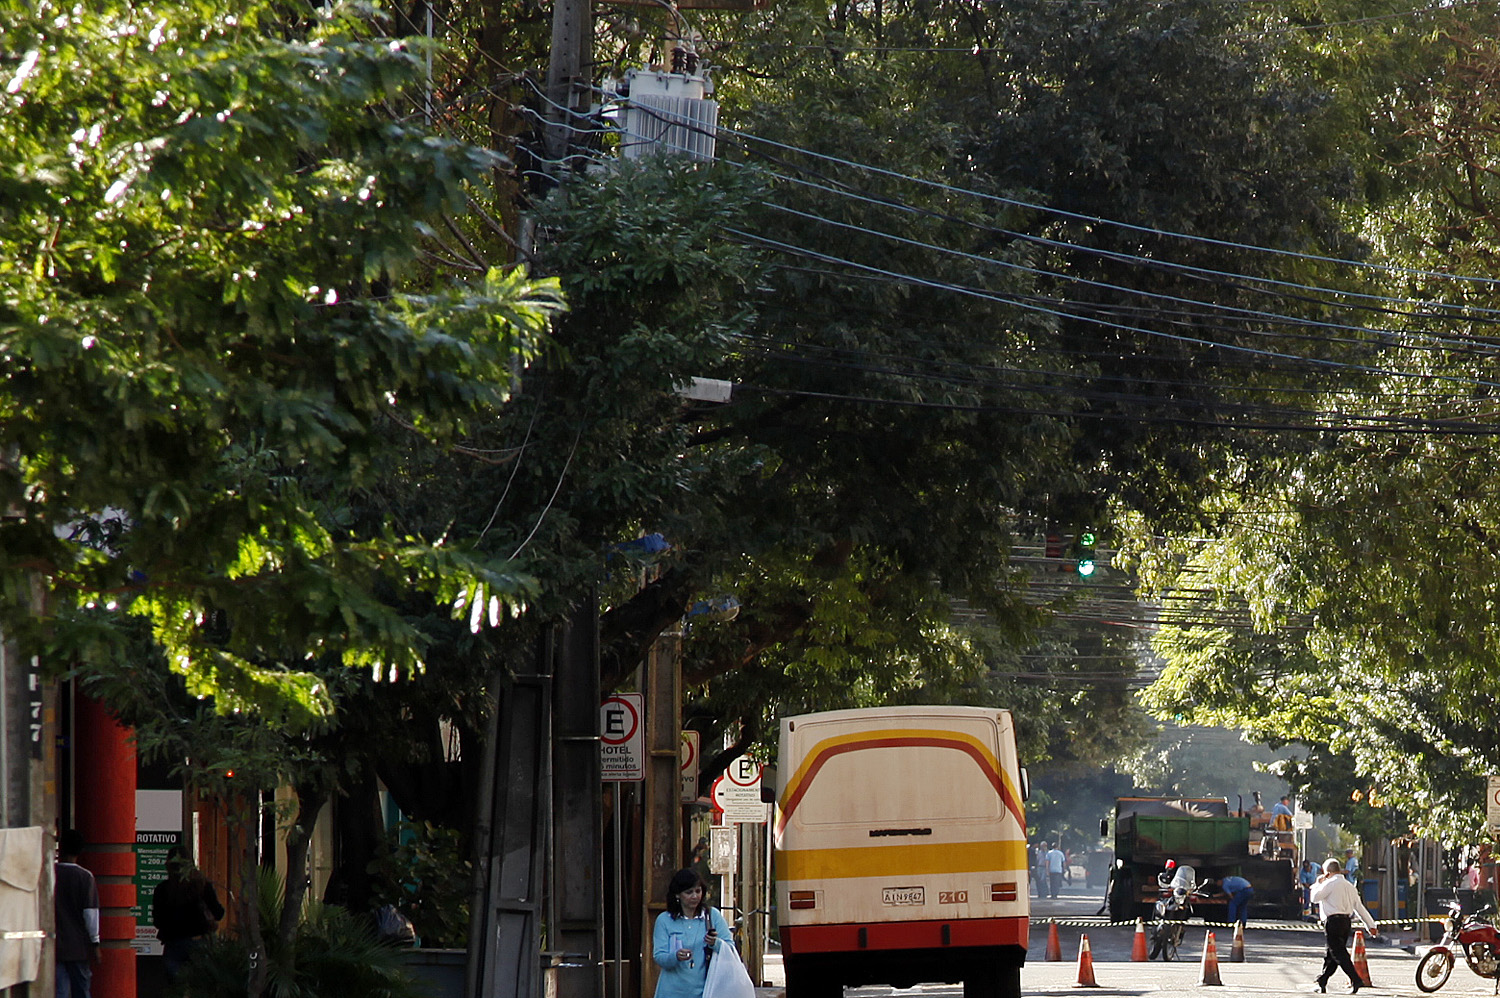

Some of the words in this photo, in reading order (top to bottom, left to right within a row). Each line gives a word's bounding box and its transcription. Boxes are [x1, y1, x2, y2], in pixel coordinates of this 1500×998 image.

[606, 710, 624, 734] E
[739, 760, 750, 779] E
[136, 833, 177, 843] ROTATIVO
[940, 892, 966, 903] 210
